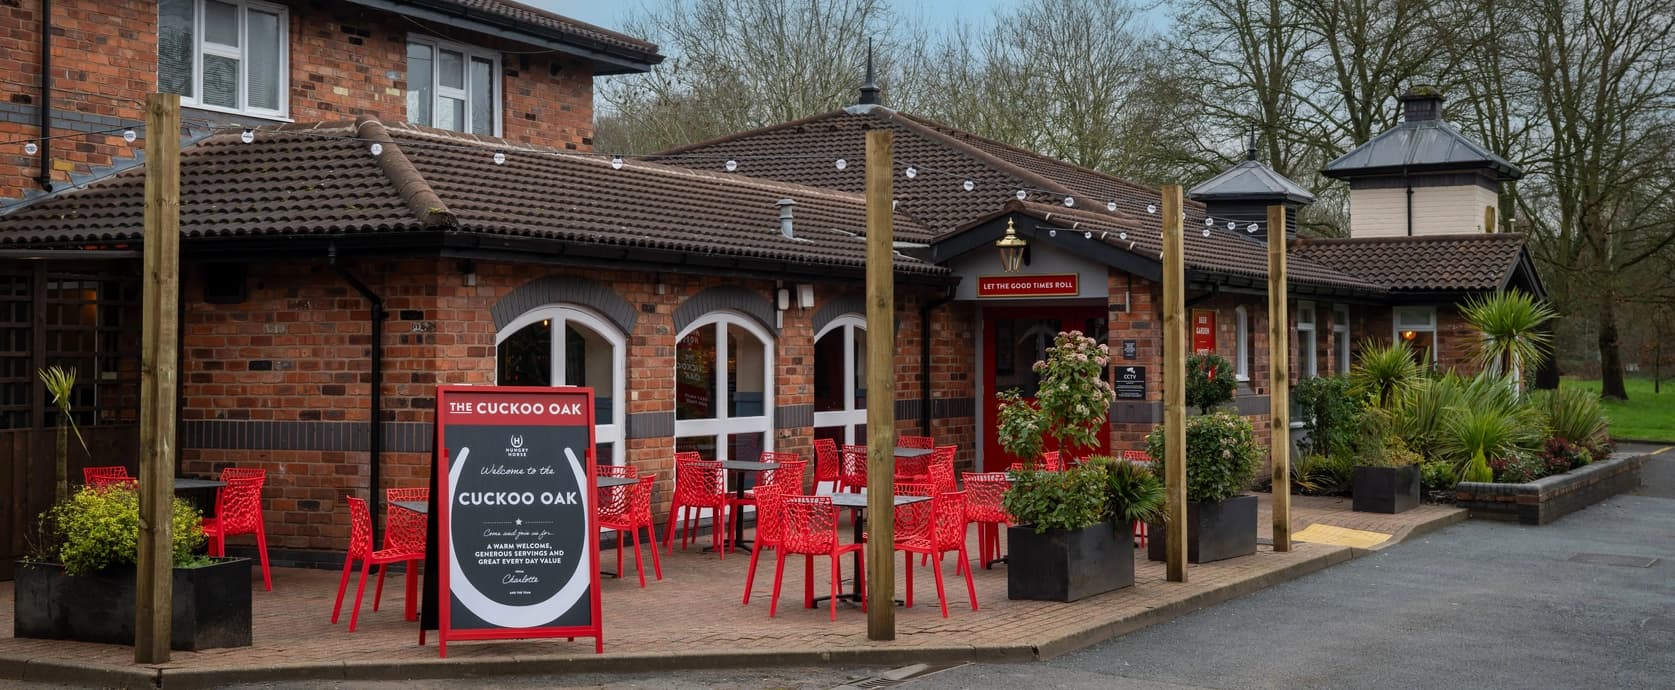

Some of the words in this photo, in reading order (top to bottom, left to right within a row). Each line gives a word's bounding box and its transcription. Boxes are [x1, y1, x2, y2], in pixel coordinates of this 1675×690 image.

[450, 402, 472, 412] THE
[476, 402, 544, 414] CUCKOO
[548, 403, 582, 415] OAK
[480, 464, 524, 475] Welcome
[527, 465, 536, 475] to
[539, 465, 555, 475] the
[458, 492, 534, 505] CUCKOO
[540, 492, 578, 505] OAK
[502, 573, 539, 584] Charlotte
